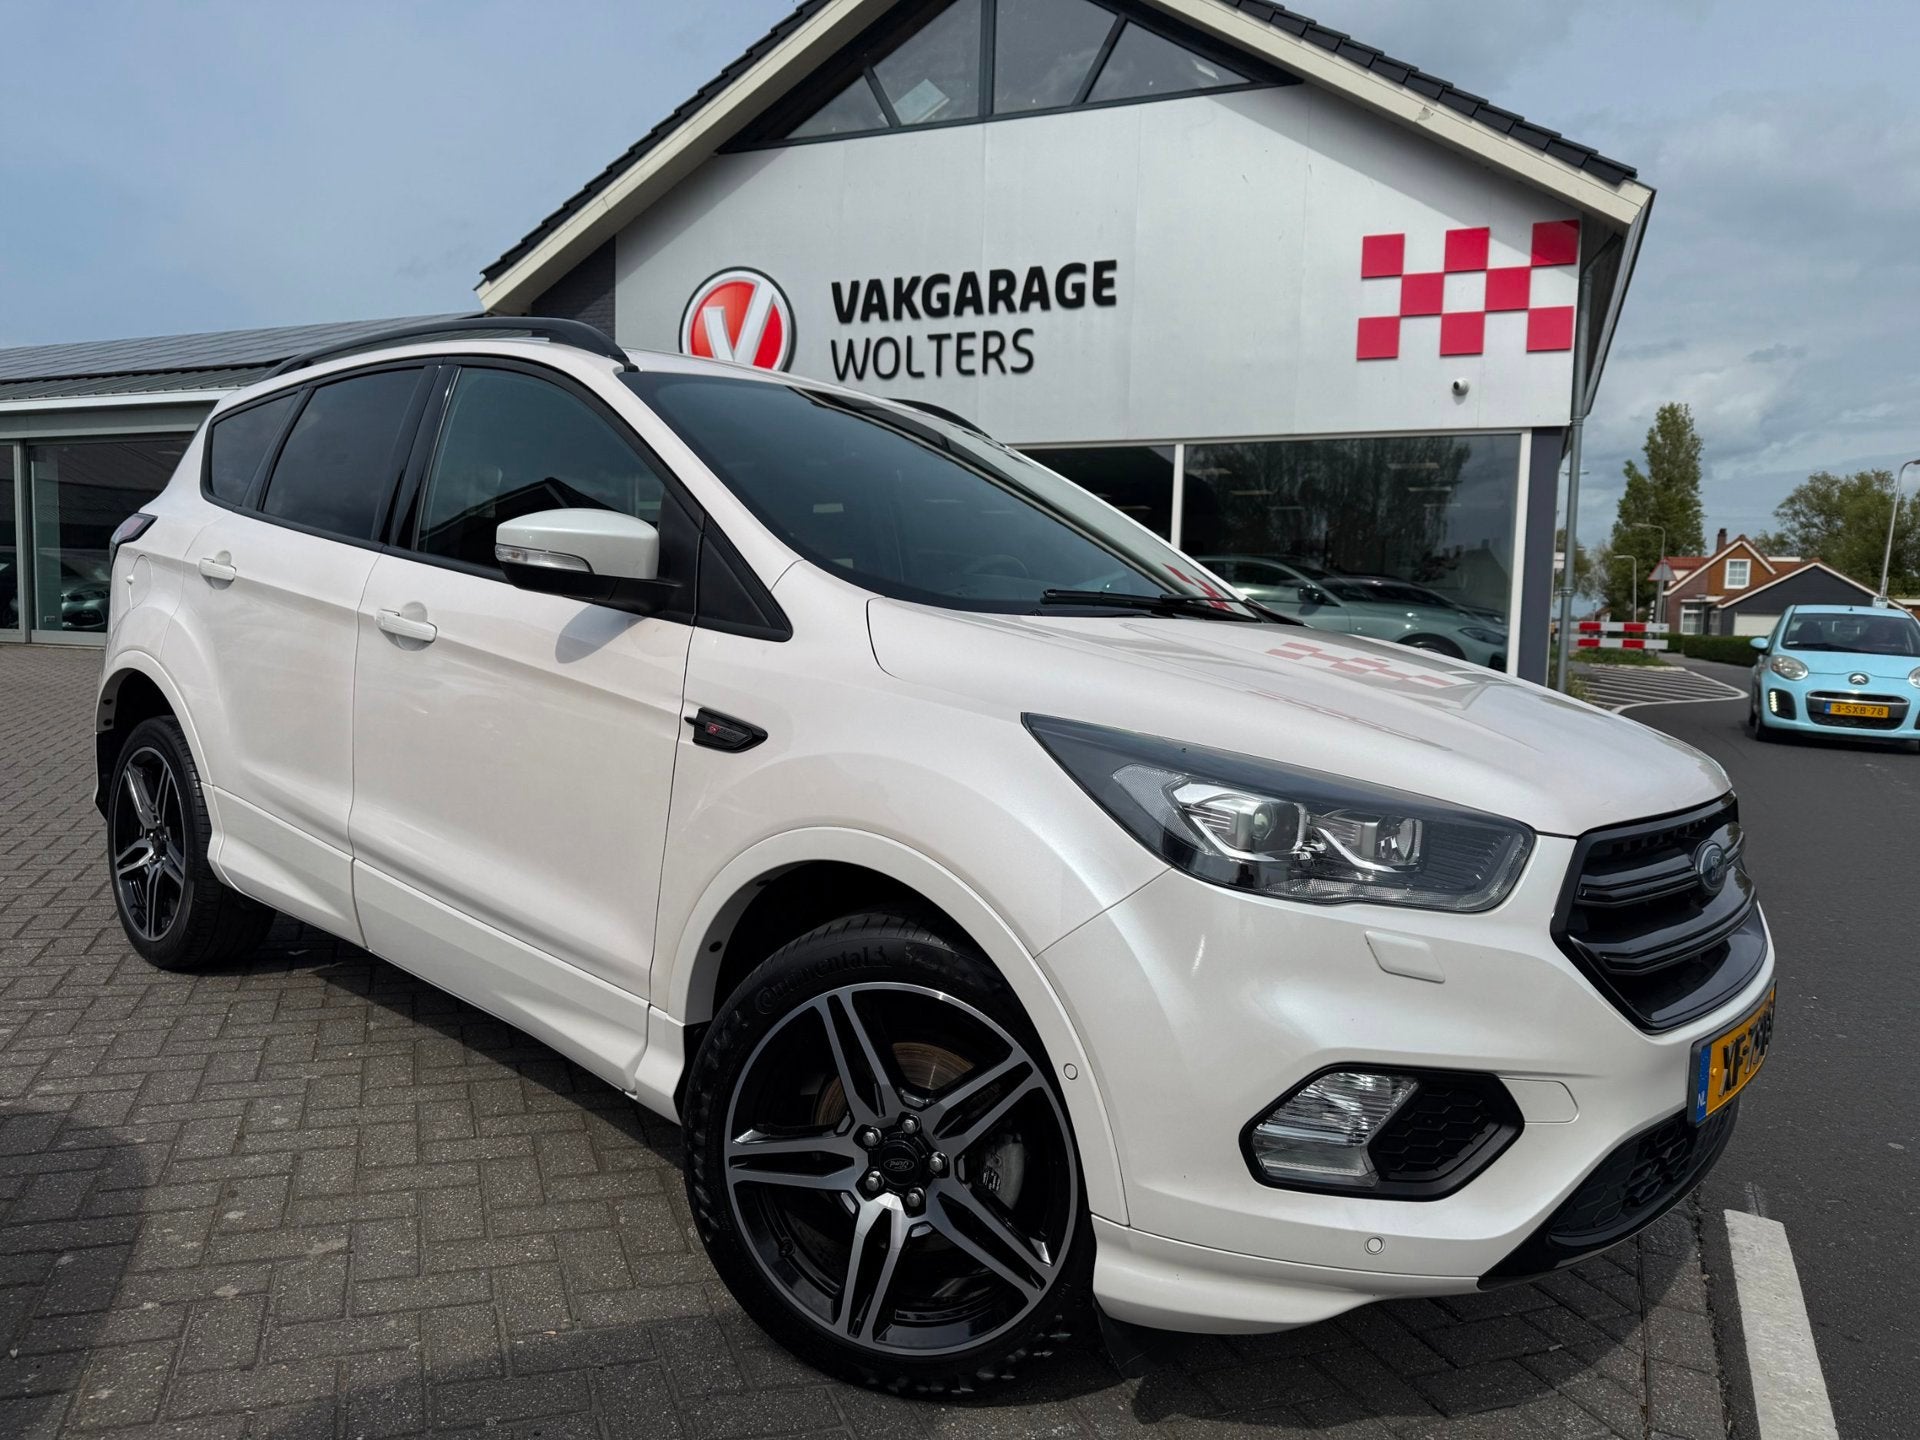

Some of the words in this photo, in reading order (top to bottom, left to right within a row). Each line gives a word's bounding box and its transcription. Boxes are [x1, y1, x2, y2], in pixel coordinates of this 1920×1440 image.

[830, 259, 1118, 325] VAKGARAGE
[830, 327, 1035, 381] WOLTERS
[1834, 704, 1884, 716] 3-SXB-78
